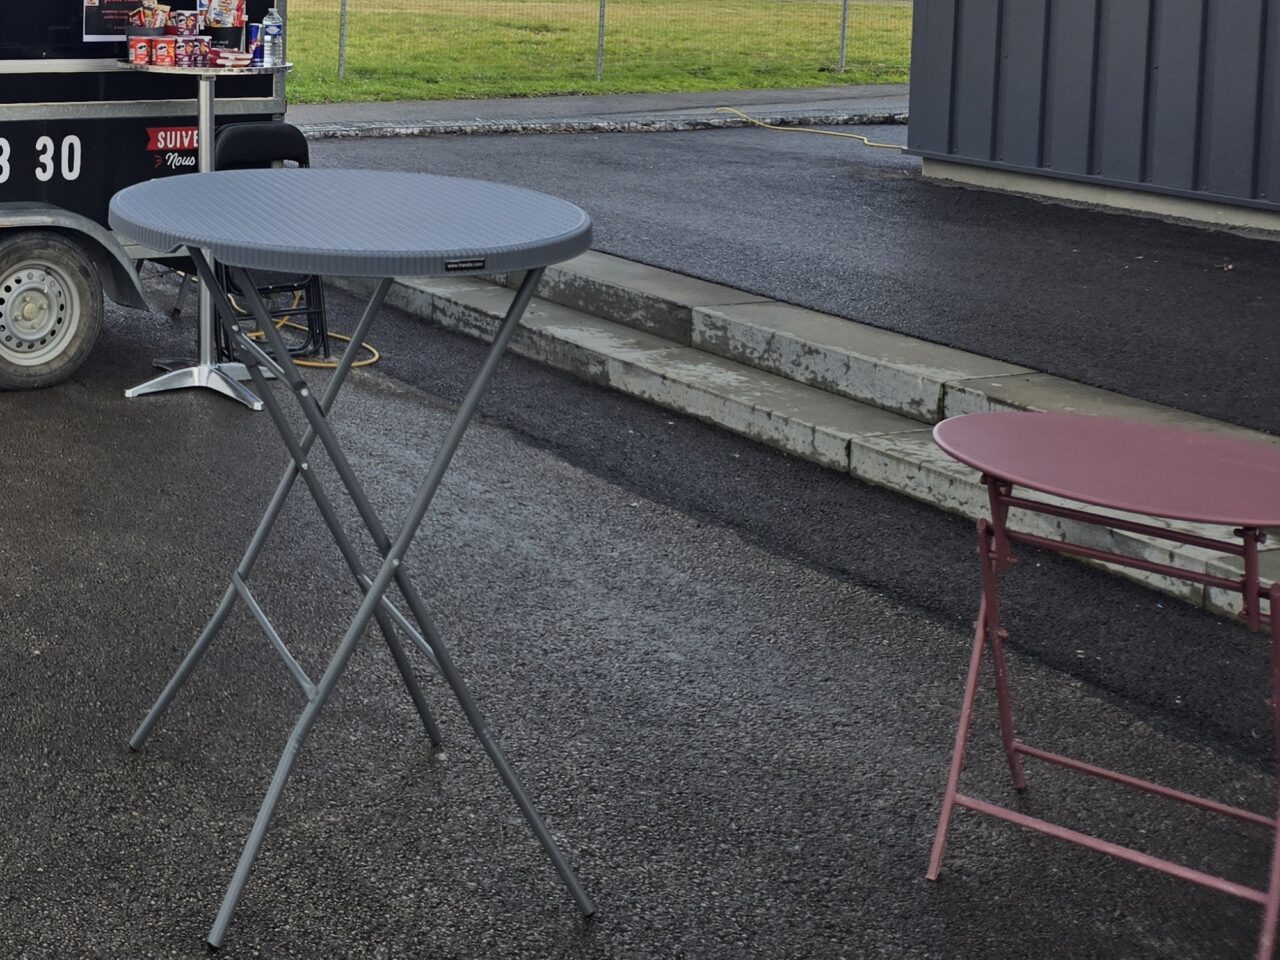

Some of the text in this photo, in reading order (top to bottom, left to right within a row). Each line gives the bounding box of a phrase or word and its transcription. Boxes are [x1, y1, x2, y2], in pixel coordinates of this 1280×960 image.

[157, 130, 199, 149] SUIVE
[35, 135, 82, 182] 30
[165, 152, 196, 170] Nous
